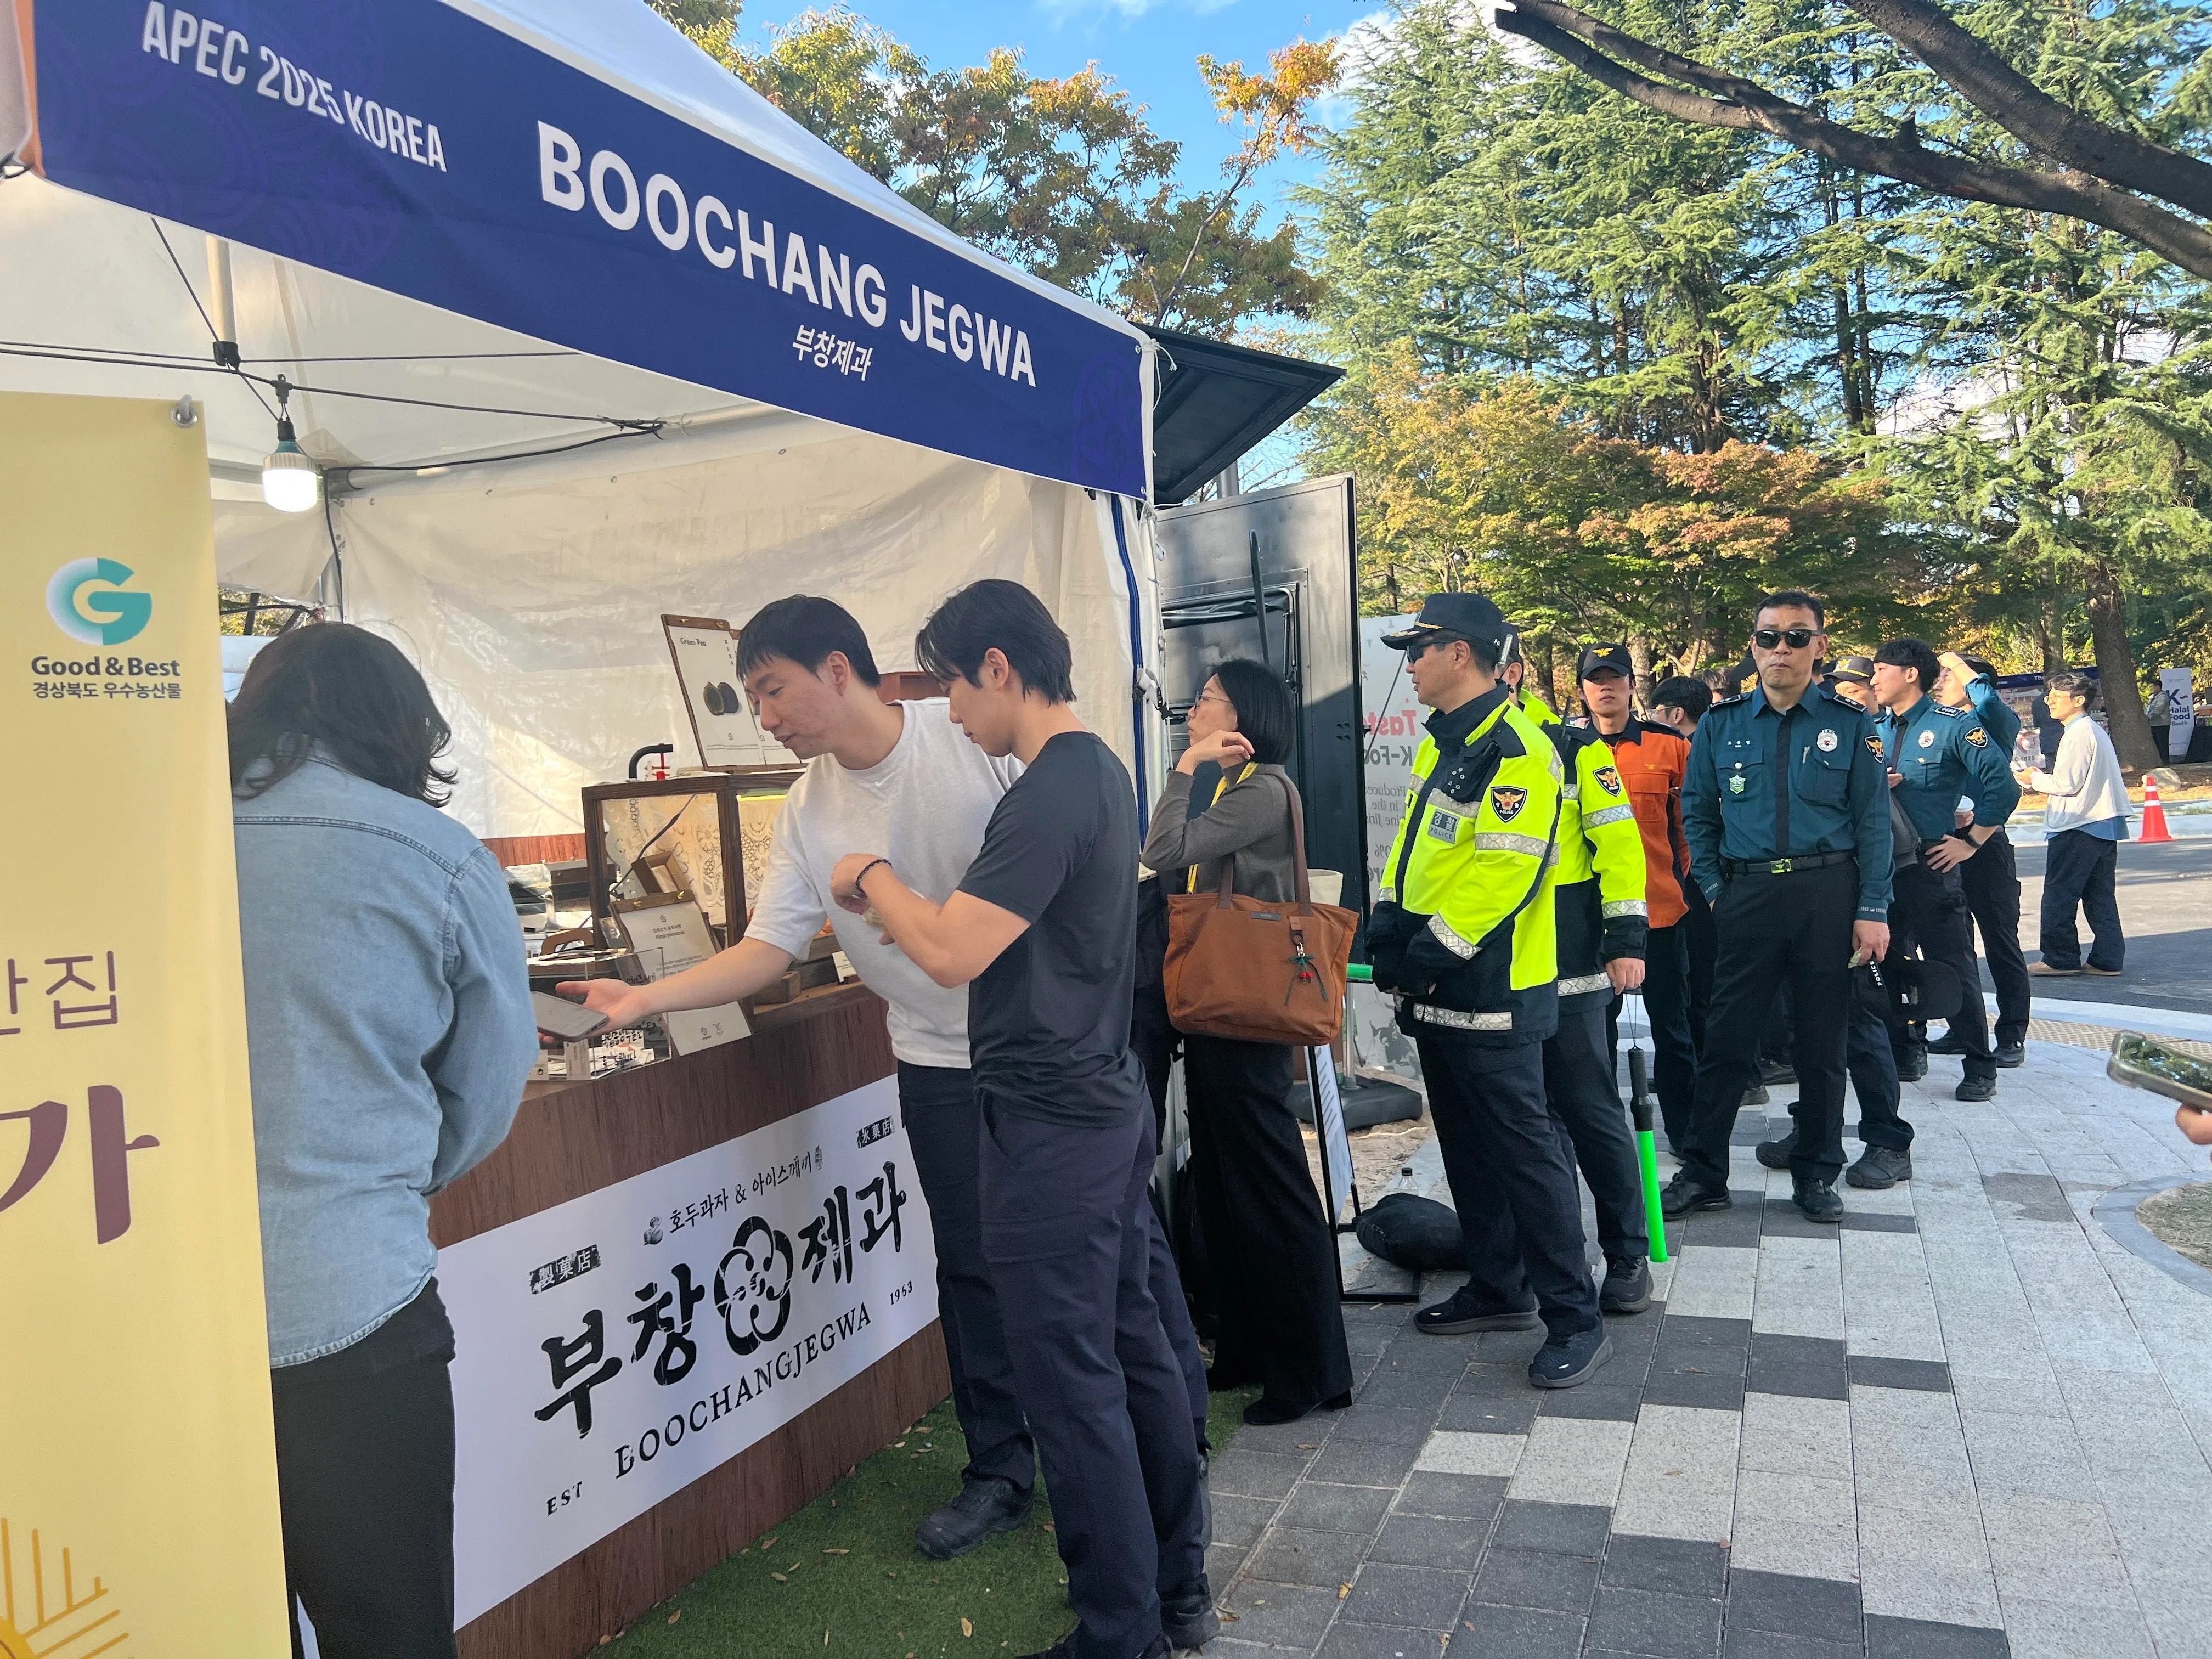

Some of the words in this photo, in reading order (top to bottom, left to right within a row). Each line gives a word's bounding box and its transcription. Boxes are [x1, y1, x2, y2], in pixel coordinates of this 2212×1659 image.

[142, 1, 249, 86] APEC
[257, 45, 345, 125] 2025
[343, 89, 447, 173] KOREA
[537, 120, 888, 328] BOOCHANG
[899, 284, 1037, 387] JEGWA
[792, 324, 873, 382] 부창제과
[31, 656, 101, 676] Good
[105, 657, 125, 676] &
[128, 657, 181, 676] Best
[33, 682, 99, 699] 경상북도
[103, 682, 182, 699] 우수농산물
[1430, 827, 1453, 839] POLICE
[1869, 960, 1883, 986] POLICE
[669, 1188, 729, 1233] 호두과자
[735, 1183, 748, 1204] &
[546, 1480, 583, 1516] EST
[890, 1280, 913, 1306] 1963
